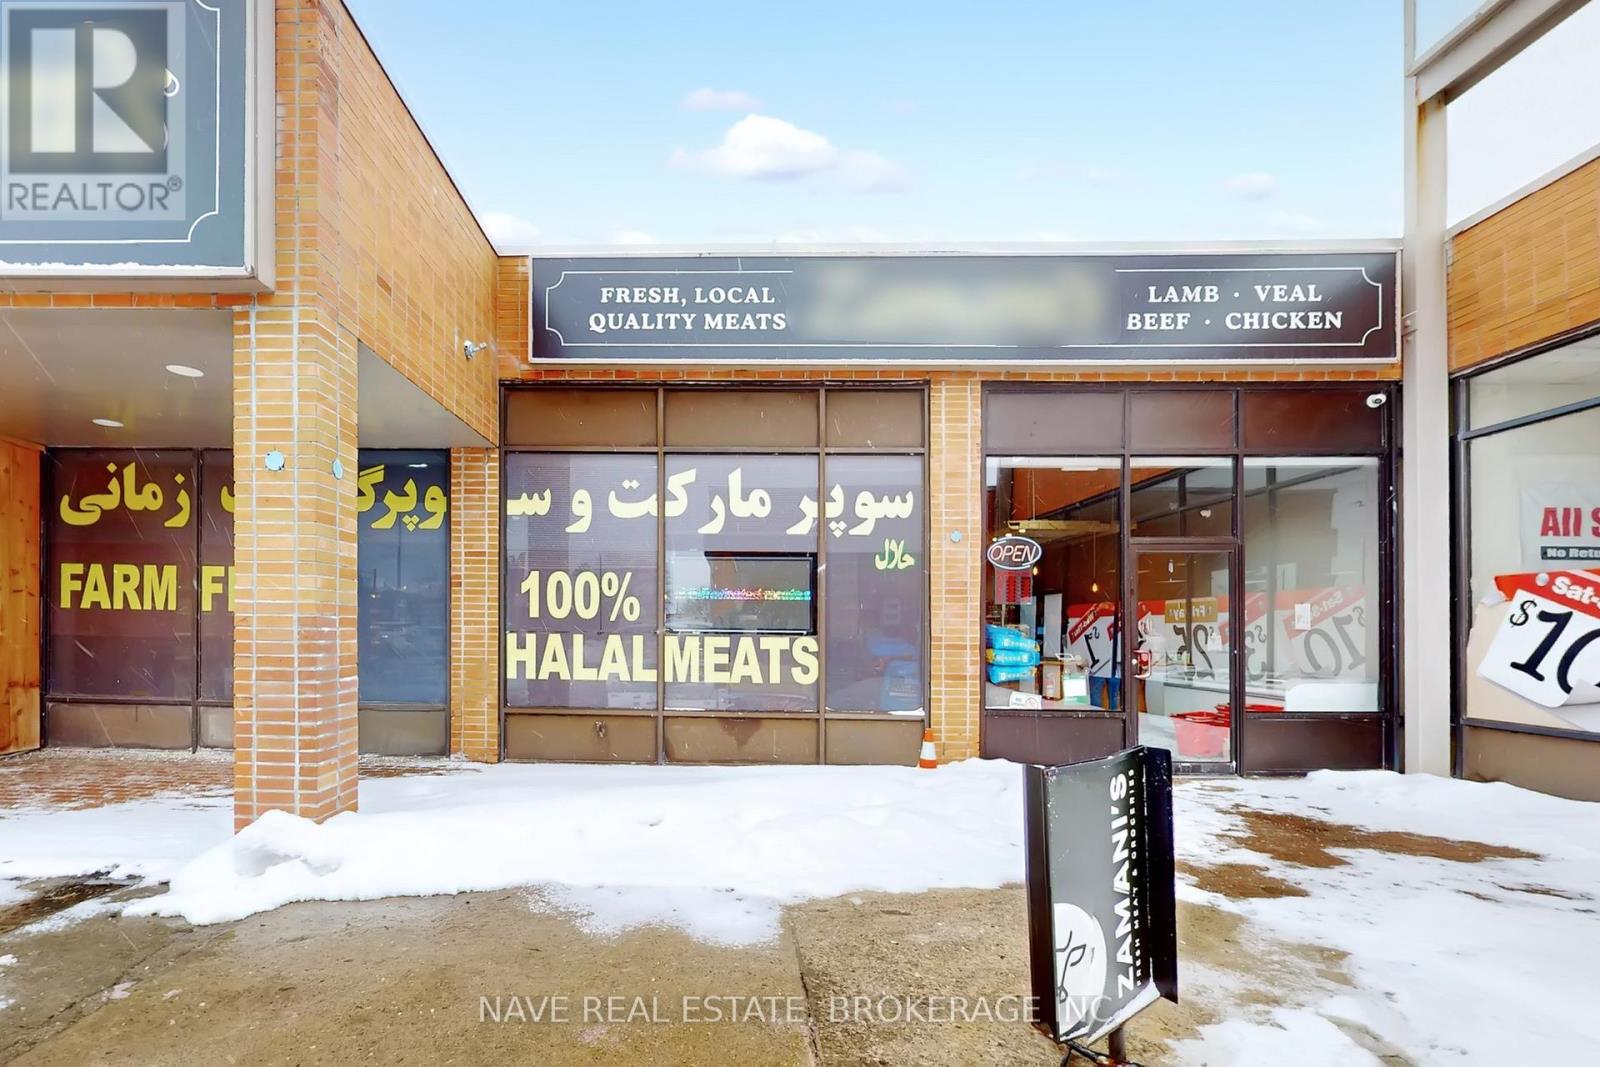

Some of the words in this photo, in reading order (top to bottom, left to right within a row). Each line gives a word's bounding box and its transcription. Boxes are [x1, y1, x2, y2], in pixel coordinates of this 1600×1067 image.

[600, 287, 687, 306] FRESH,
[694, 287, 776, 303] LOCAL
[1148, 285, 1220, 303] LAMB
[1254, 284, 1323, 302] VEAL
[588, 312, 696, 333] QUALITY
[703, 313, 787, 330] MEATS
[1126, 312, 1191, 330] BEEF
[1225, 311, 1344, 330] CHICKEN
[565, 488, 593, 533] و
[990, 545, 1036, 562] OPEN
[1546, 548, 1567, 558] No
[60, 562, 177, 611] FARM
[520, 570, 641, 622] 100%
[1551, 575, 1600, 606] Sat-
[506, 633, 657, 681] HALAL
[664, 635, 820, 685] MEATS
[1110, 773, 1135, 999] ZAMANI'S
